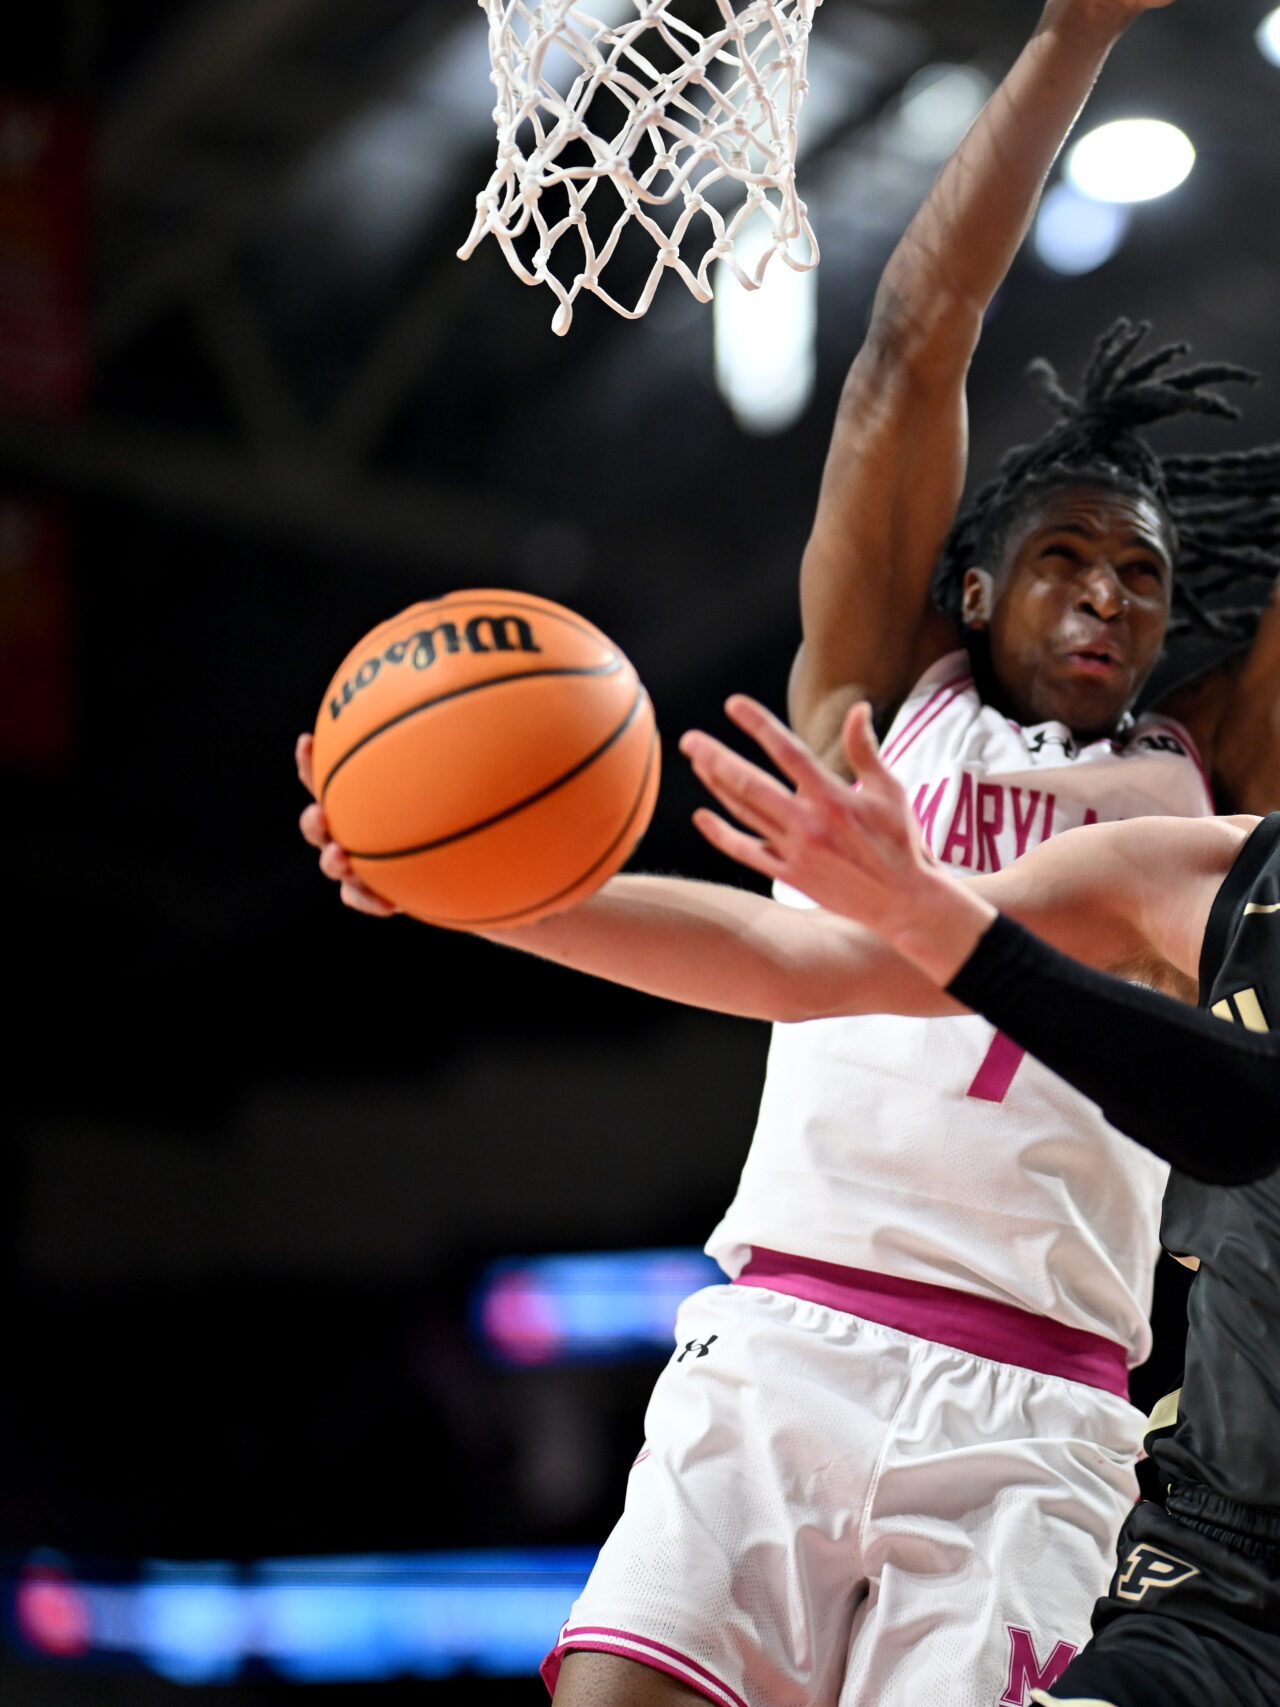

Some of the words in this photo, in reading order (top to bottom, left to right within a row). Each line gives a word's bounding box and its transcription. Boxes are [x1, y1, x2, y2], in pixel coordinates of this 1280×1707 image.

[330, 615, 541, 720] Wilson
[1116, 1543, 1200, 1601] P
[1000, 1625, 1079, 1707] M
